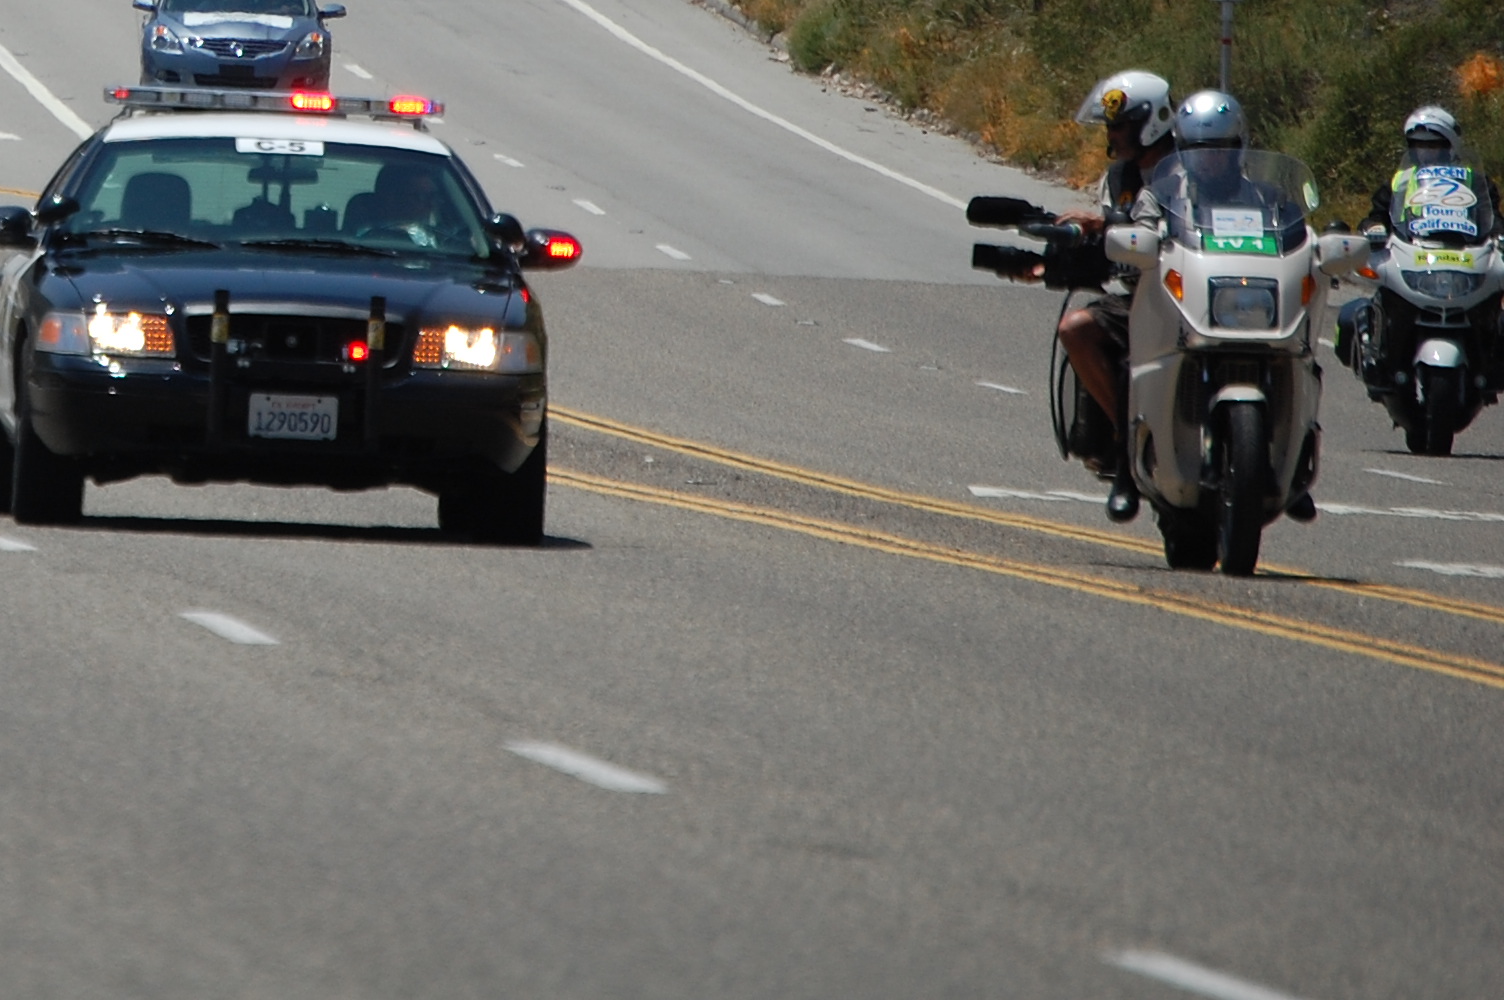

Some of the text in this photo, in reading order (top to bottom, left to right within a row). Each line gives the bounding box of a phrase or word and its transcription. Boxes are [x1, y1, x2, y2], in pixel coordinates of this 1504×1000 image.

[255, 140, 306, 153] C-5
[1425, 205, 1453, 216] Tour
[1410, 218, 1476, 234] California
[1212, 238, 1264, 250] TV 1
[255, 411, 332, 434] 1290590
